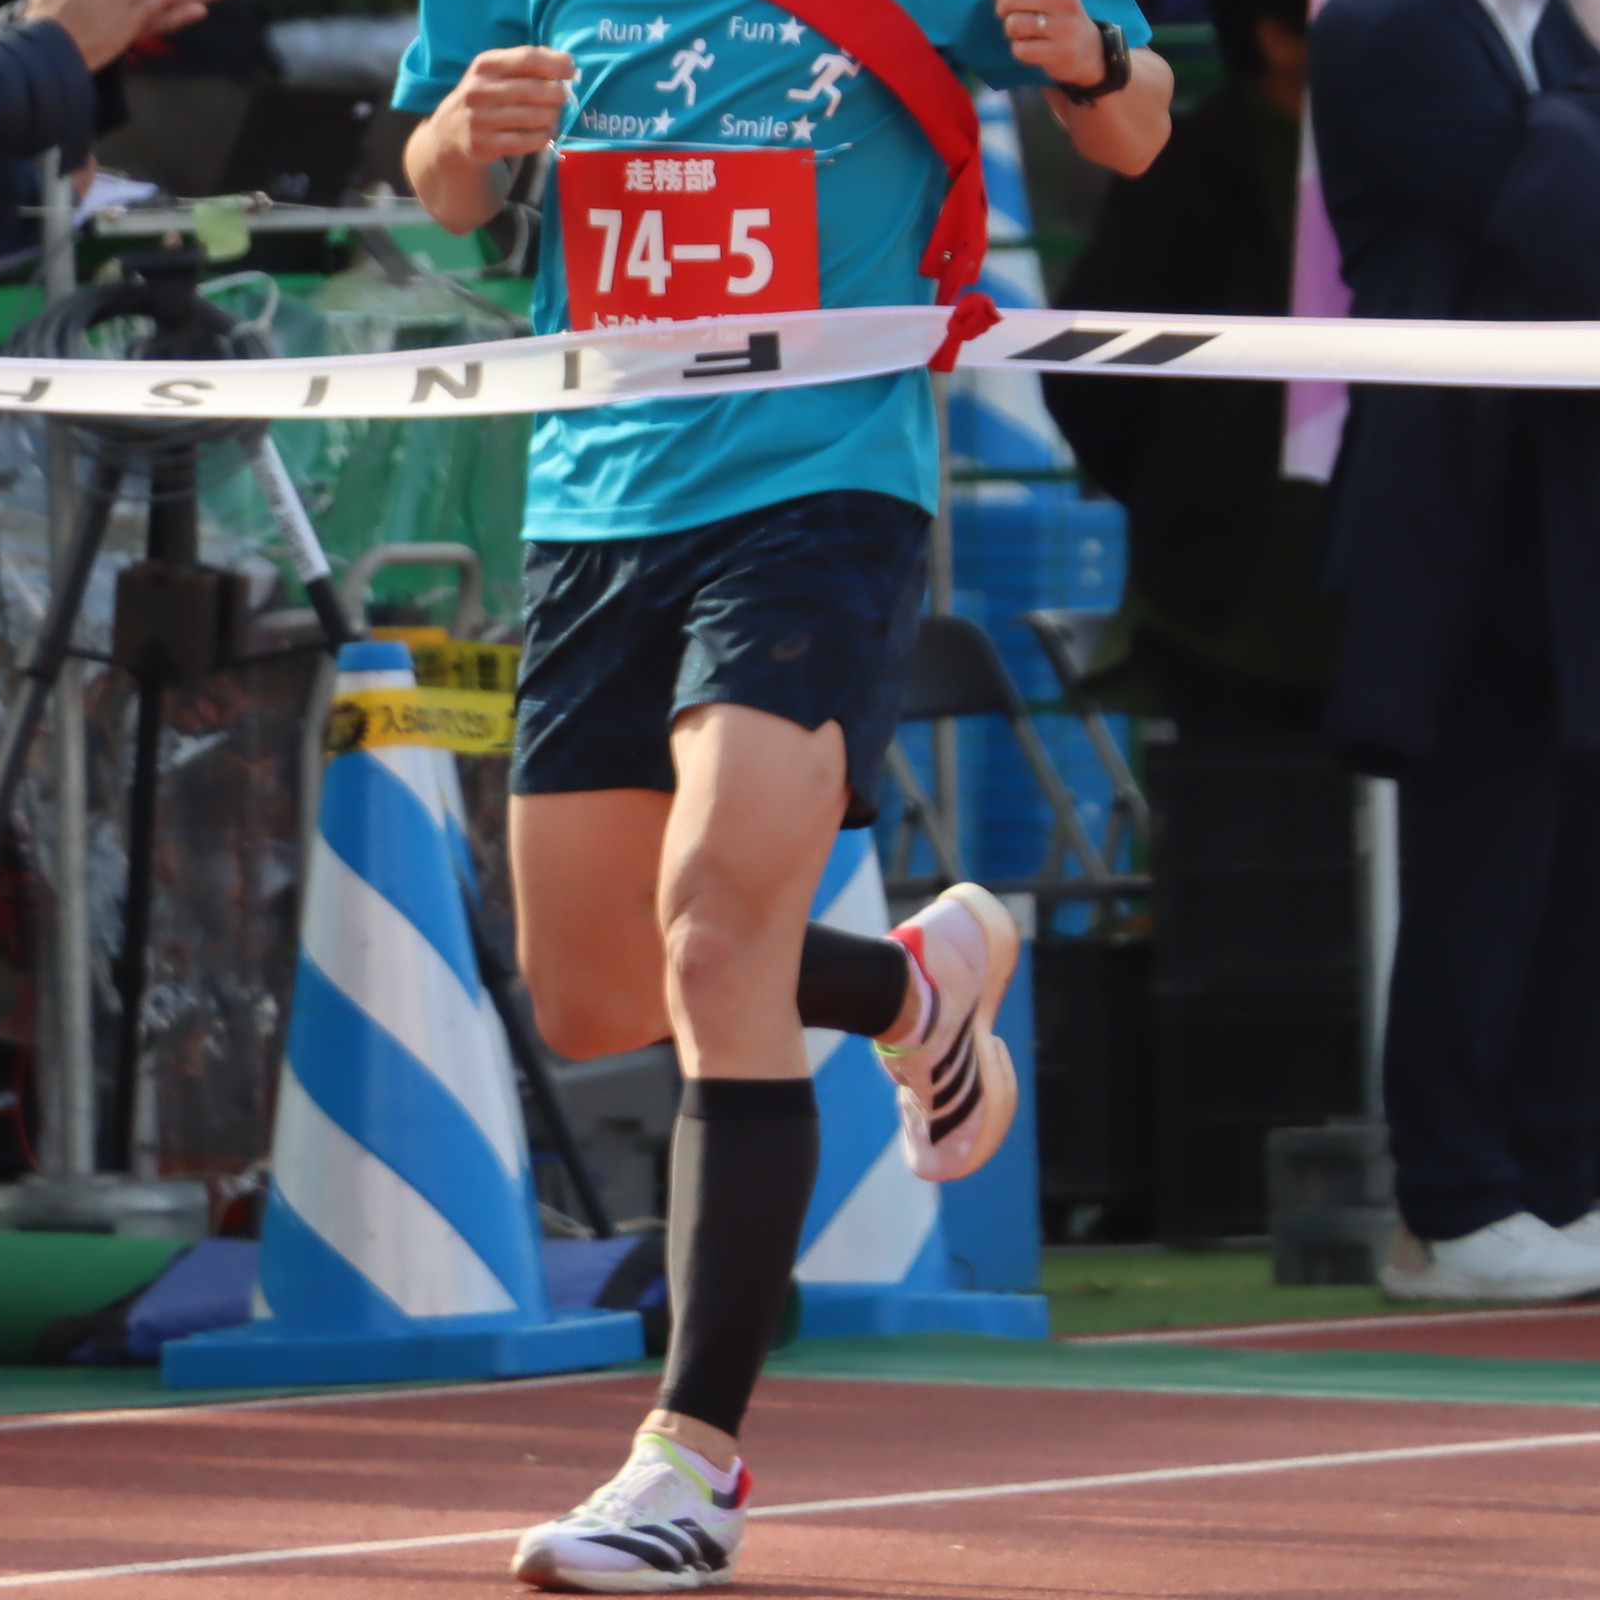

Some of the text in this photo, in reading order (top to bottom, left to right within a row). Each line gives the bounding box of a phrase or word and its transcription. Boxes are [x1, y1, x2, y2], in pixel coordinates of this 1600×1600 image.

[599, 16, 775, 41] Run Fun
[581, 109, 789, 139] Happy Smile
[626, 159, 717, 192] 走務部
[588, 207, 774, 296] 74-5
